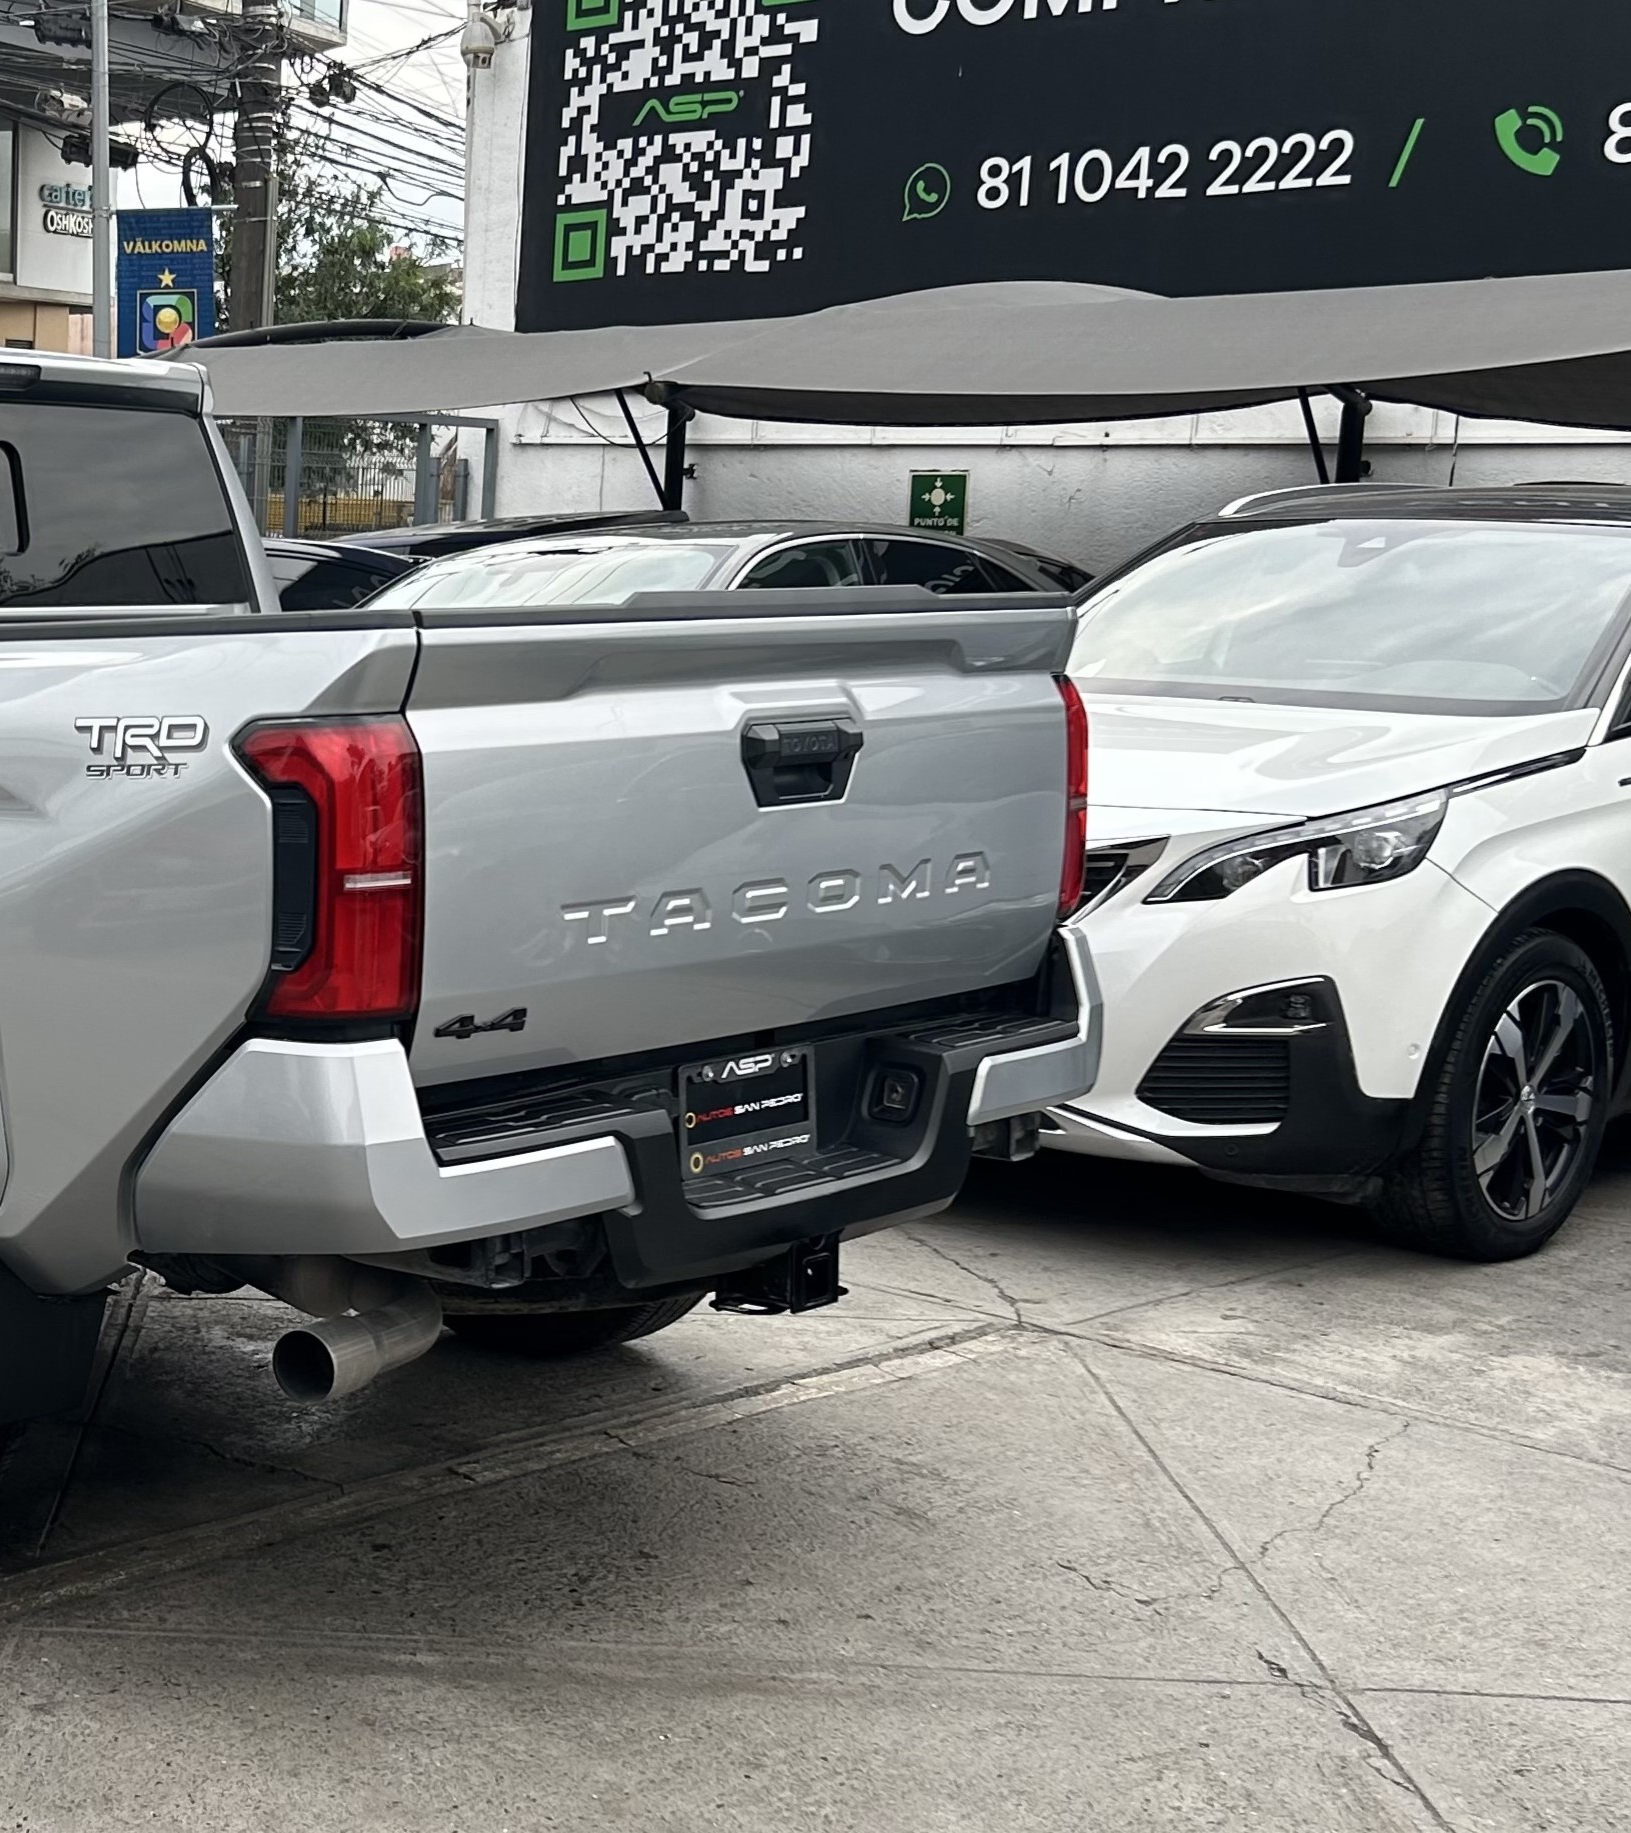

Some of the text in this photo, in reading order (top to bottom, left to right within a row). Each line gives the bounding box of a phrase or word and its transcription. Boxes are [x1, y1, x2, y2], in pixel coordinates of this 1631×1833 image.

[632, 91, 738, 126] ASP
[977, 155, 1030, 209] 81
[1049, 144, 1188, 204] 1042
[1206, 129, 1354, 196] 2222
[39, 184, 93, 208] carter
[123, 238, 207, 254] VÄLKOMNA
[914, 517, 959, 527] PUNTO DE
[74, 715, 210, 763] TRD
[85, 763, 189, 780] SPORT
[560, 851, 991, 944] TACOMA
[721, 1054, 773, 1079] ASP
[696, 1093, 803, 1123] AUTOS SAN PEDRO
[705, 1134, 810, 1165] AUTOS SAN PEDRO
